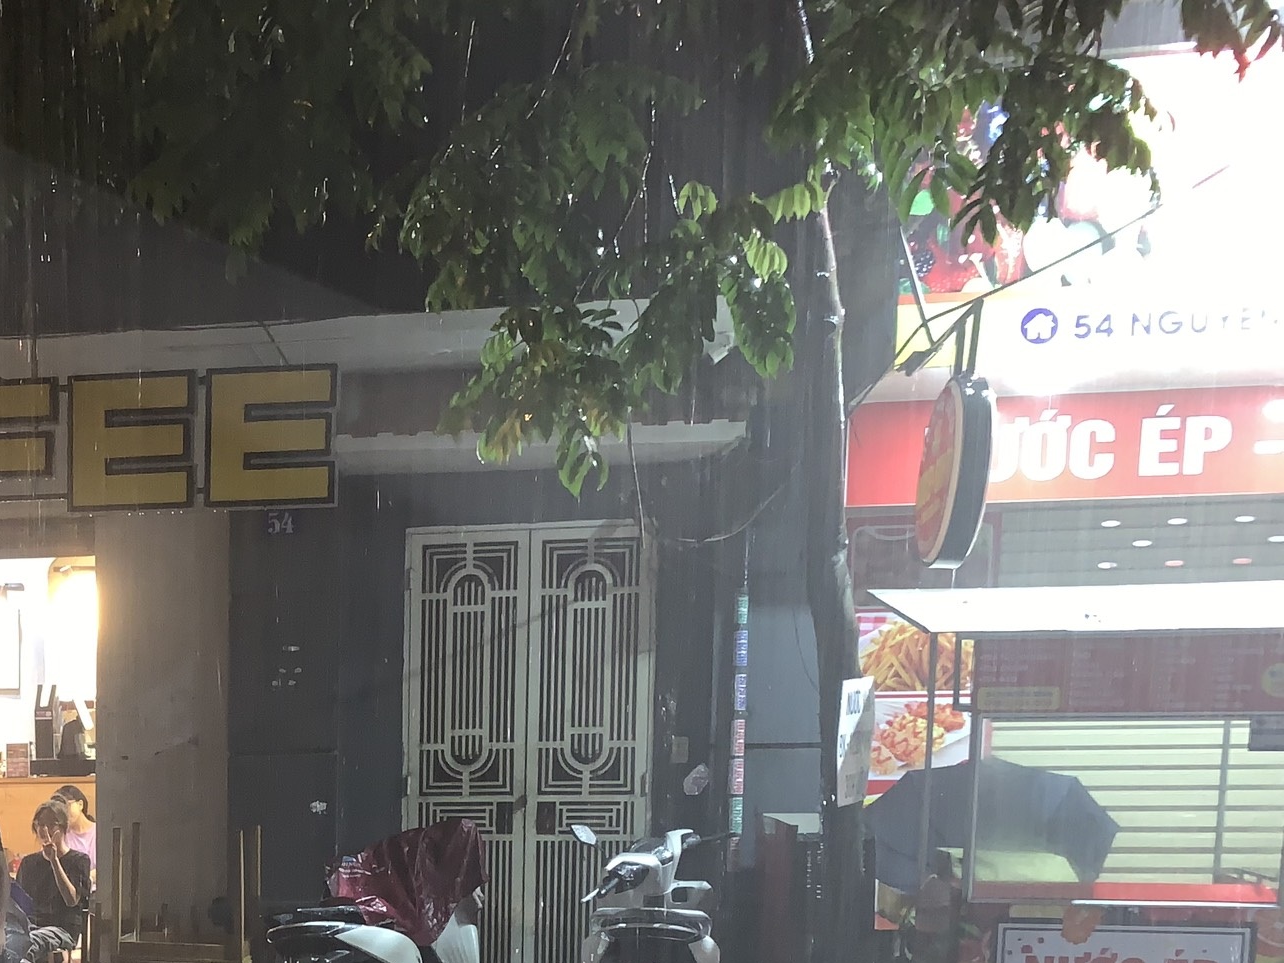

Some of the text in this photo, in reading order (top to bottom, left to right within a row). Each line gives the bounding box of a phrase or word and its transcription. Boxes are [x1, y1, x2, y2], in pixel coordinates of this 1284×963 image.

[1074, 314, 1114, 339] 54
[988, 408, 1117, 483] ƯỚC
[1137, 403, 1234, 478] ÉP
[267, 511, 294, 534] 54
